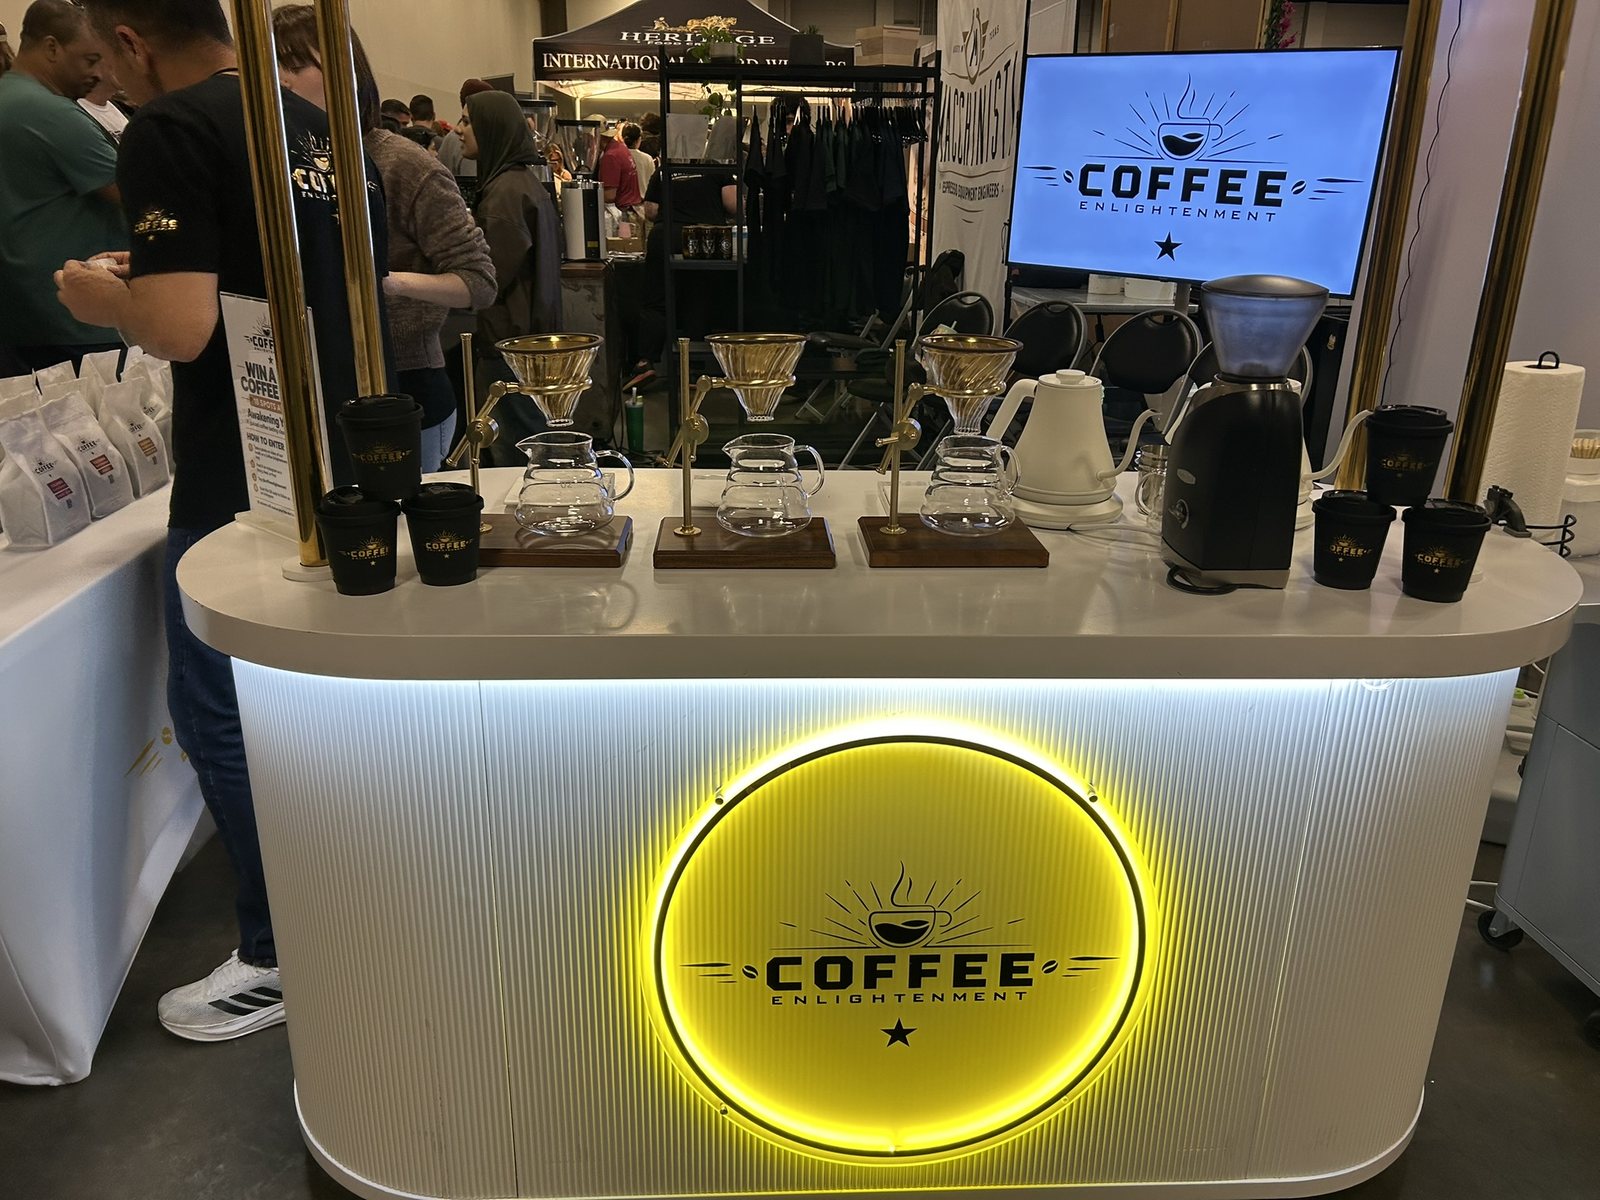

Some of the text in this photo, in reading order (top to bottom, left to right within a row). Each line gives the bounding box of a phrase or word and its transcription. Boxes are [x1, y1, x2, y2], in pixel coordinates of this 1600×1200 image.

[619, 32, 775, 45] HERITGE
[1078, 163, 1287, 207] COFFEE
[1079, 201, 1276, 222] ENLIGHTENMENT
[252, 335, 274, 350] COFF
[244, 361, 278, 385] WIN A
[240, 376, 280, 400] COFFEE
[246, 432, 285, 451] HOW TO ENTER
[425, 541, 466, 550] COFFEE
[1330, 545, 1364, 555] OFFEE
[766, 952, 1035, 991] COFFEE
[772, 991, 1027, 1005] ENLIGHTENMENT
